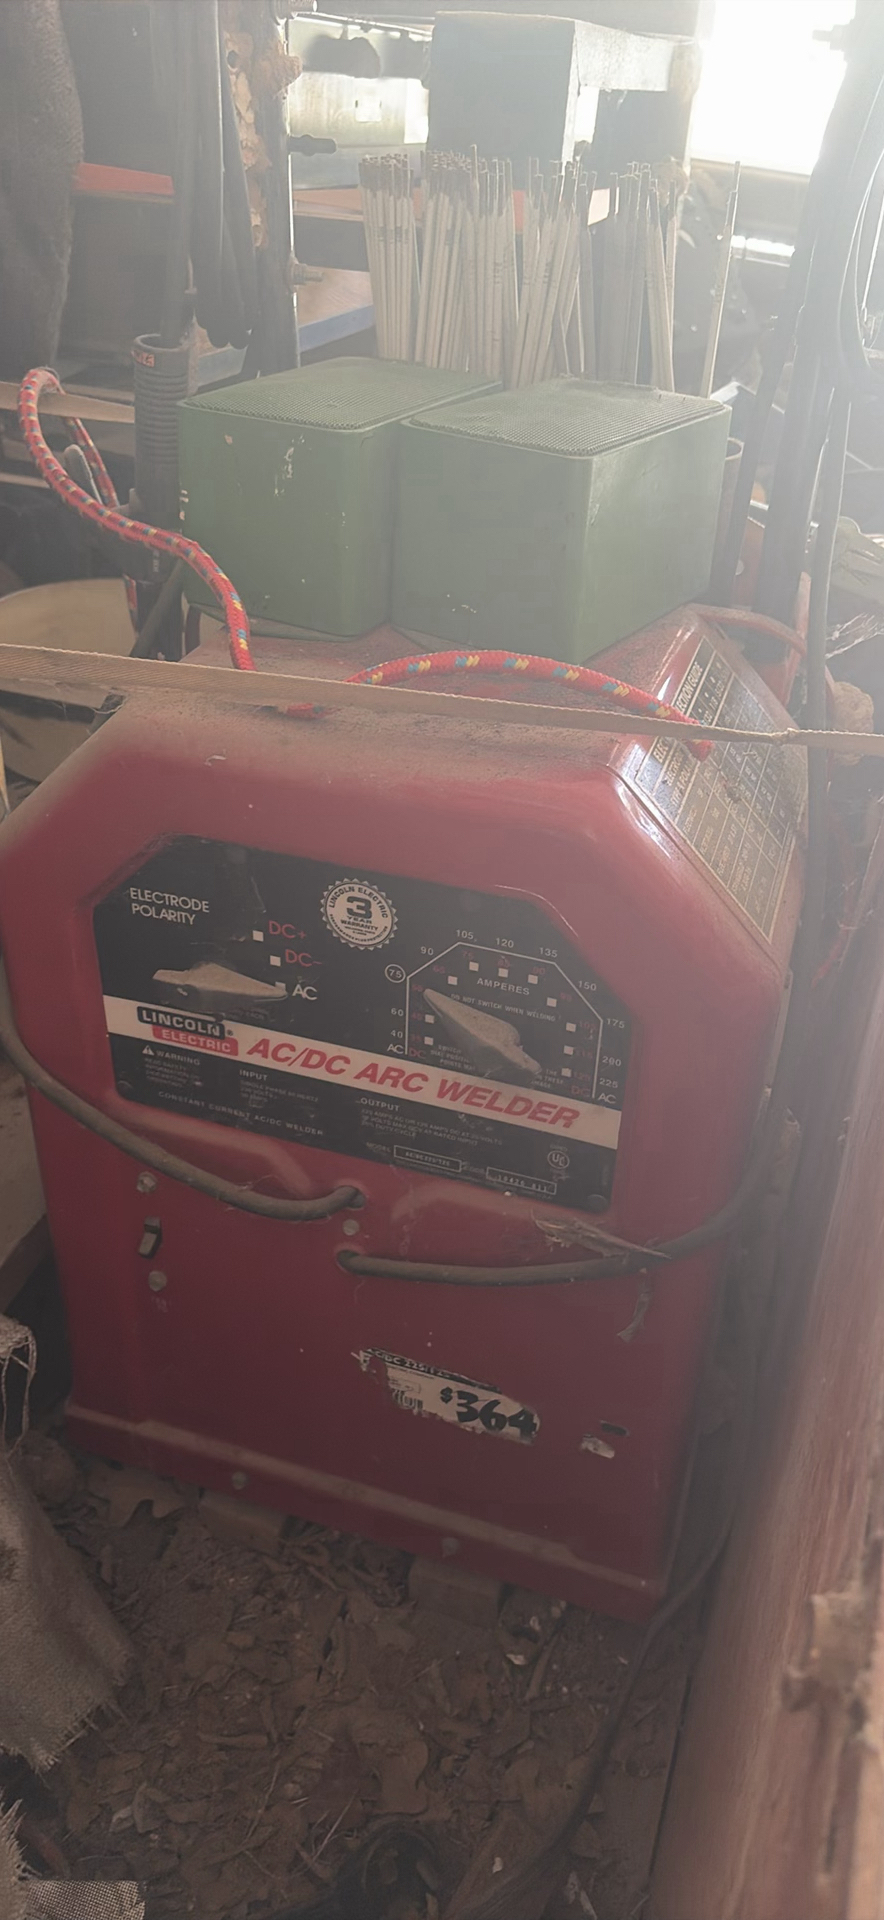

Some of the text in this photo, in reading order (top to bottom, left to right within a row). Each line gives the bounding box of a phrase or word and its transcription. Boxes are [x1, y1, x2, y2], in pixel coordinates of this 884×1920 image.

[686, 660, 704, 688] GUIDE
[129, 886, 210, 913] ELECTRODE
[328, 886, 389, 919] LINCOLN ELECTRIC
[346, 896, 373, 919] 3
[131, 903, 196, 926] POLARITY
[346, 915, 373, 925] YEAR
[268, 919, 306, 939] DC+
[340, 919, 379, 931] WARRANTY
[455, 930, 475, 941] 105
[495, 937, 514, 949] 120
[420, 946, 434, 956] 90
[539, 947, 558, 958] 135
[389, 969, 402, 980] 75
[292, 983, 318, 1001] AC
[476, 977, 531, 996] AMPERES
[578, 980, 597, 991] 150
[391, 1008, 404, 1017] 60
[463, 995, 475, 1004] NOT
[478, 998, 503, 1009] SWITCH
[504, 1004, 524, 1015] WHEN
[526, 1009, 556, 1022] WELDING
[141, 1009, 221, 1037] LINCOLN
[606, 1018, 625, 1029] 175
[391, 1029, 404, 1039] 40
[161, 1029, 232, 1053] ELECTRIC
[386, 1043, 404, 1055] AC
[408, 1047, 426, 1060] DC
[155, 1049, 201, 1067] WARNING
[601, 1055, 622, 1067] 200
[239, 1069, 268, 1081] INPUT
[245, 1037, 582, 1131] AC/DC ARC WELDER
[598, 1077, 619, 1089] 225
[360, 1097, 400, 1112] OUTPUT
[597, 1092, 617, 1104] AC
[158, 1090, 324, 1136] CONSTANT CURRENT AC/DC WELDER
[439, 1386, 538, 1439] $364
